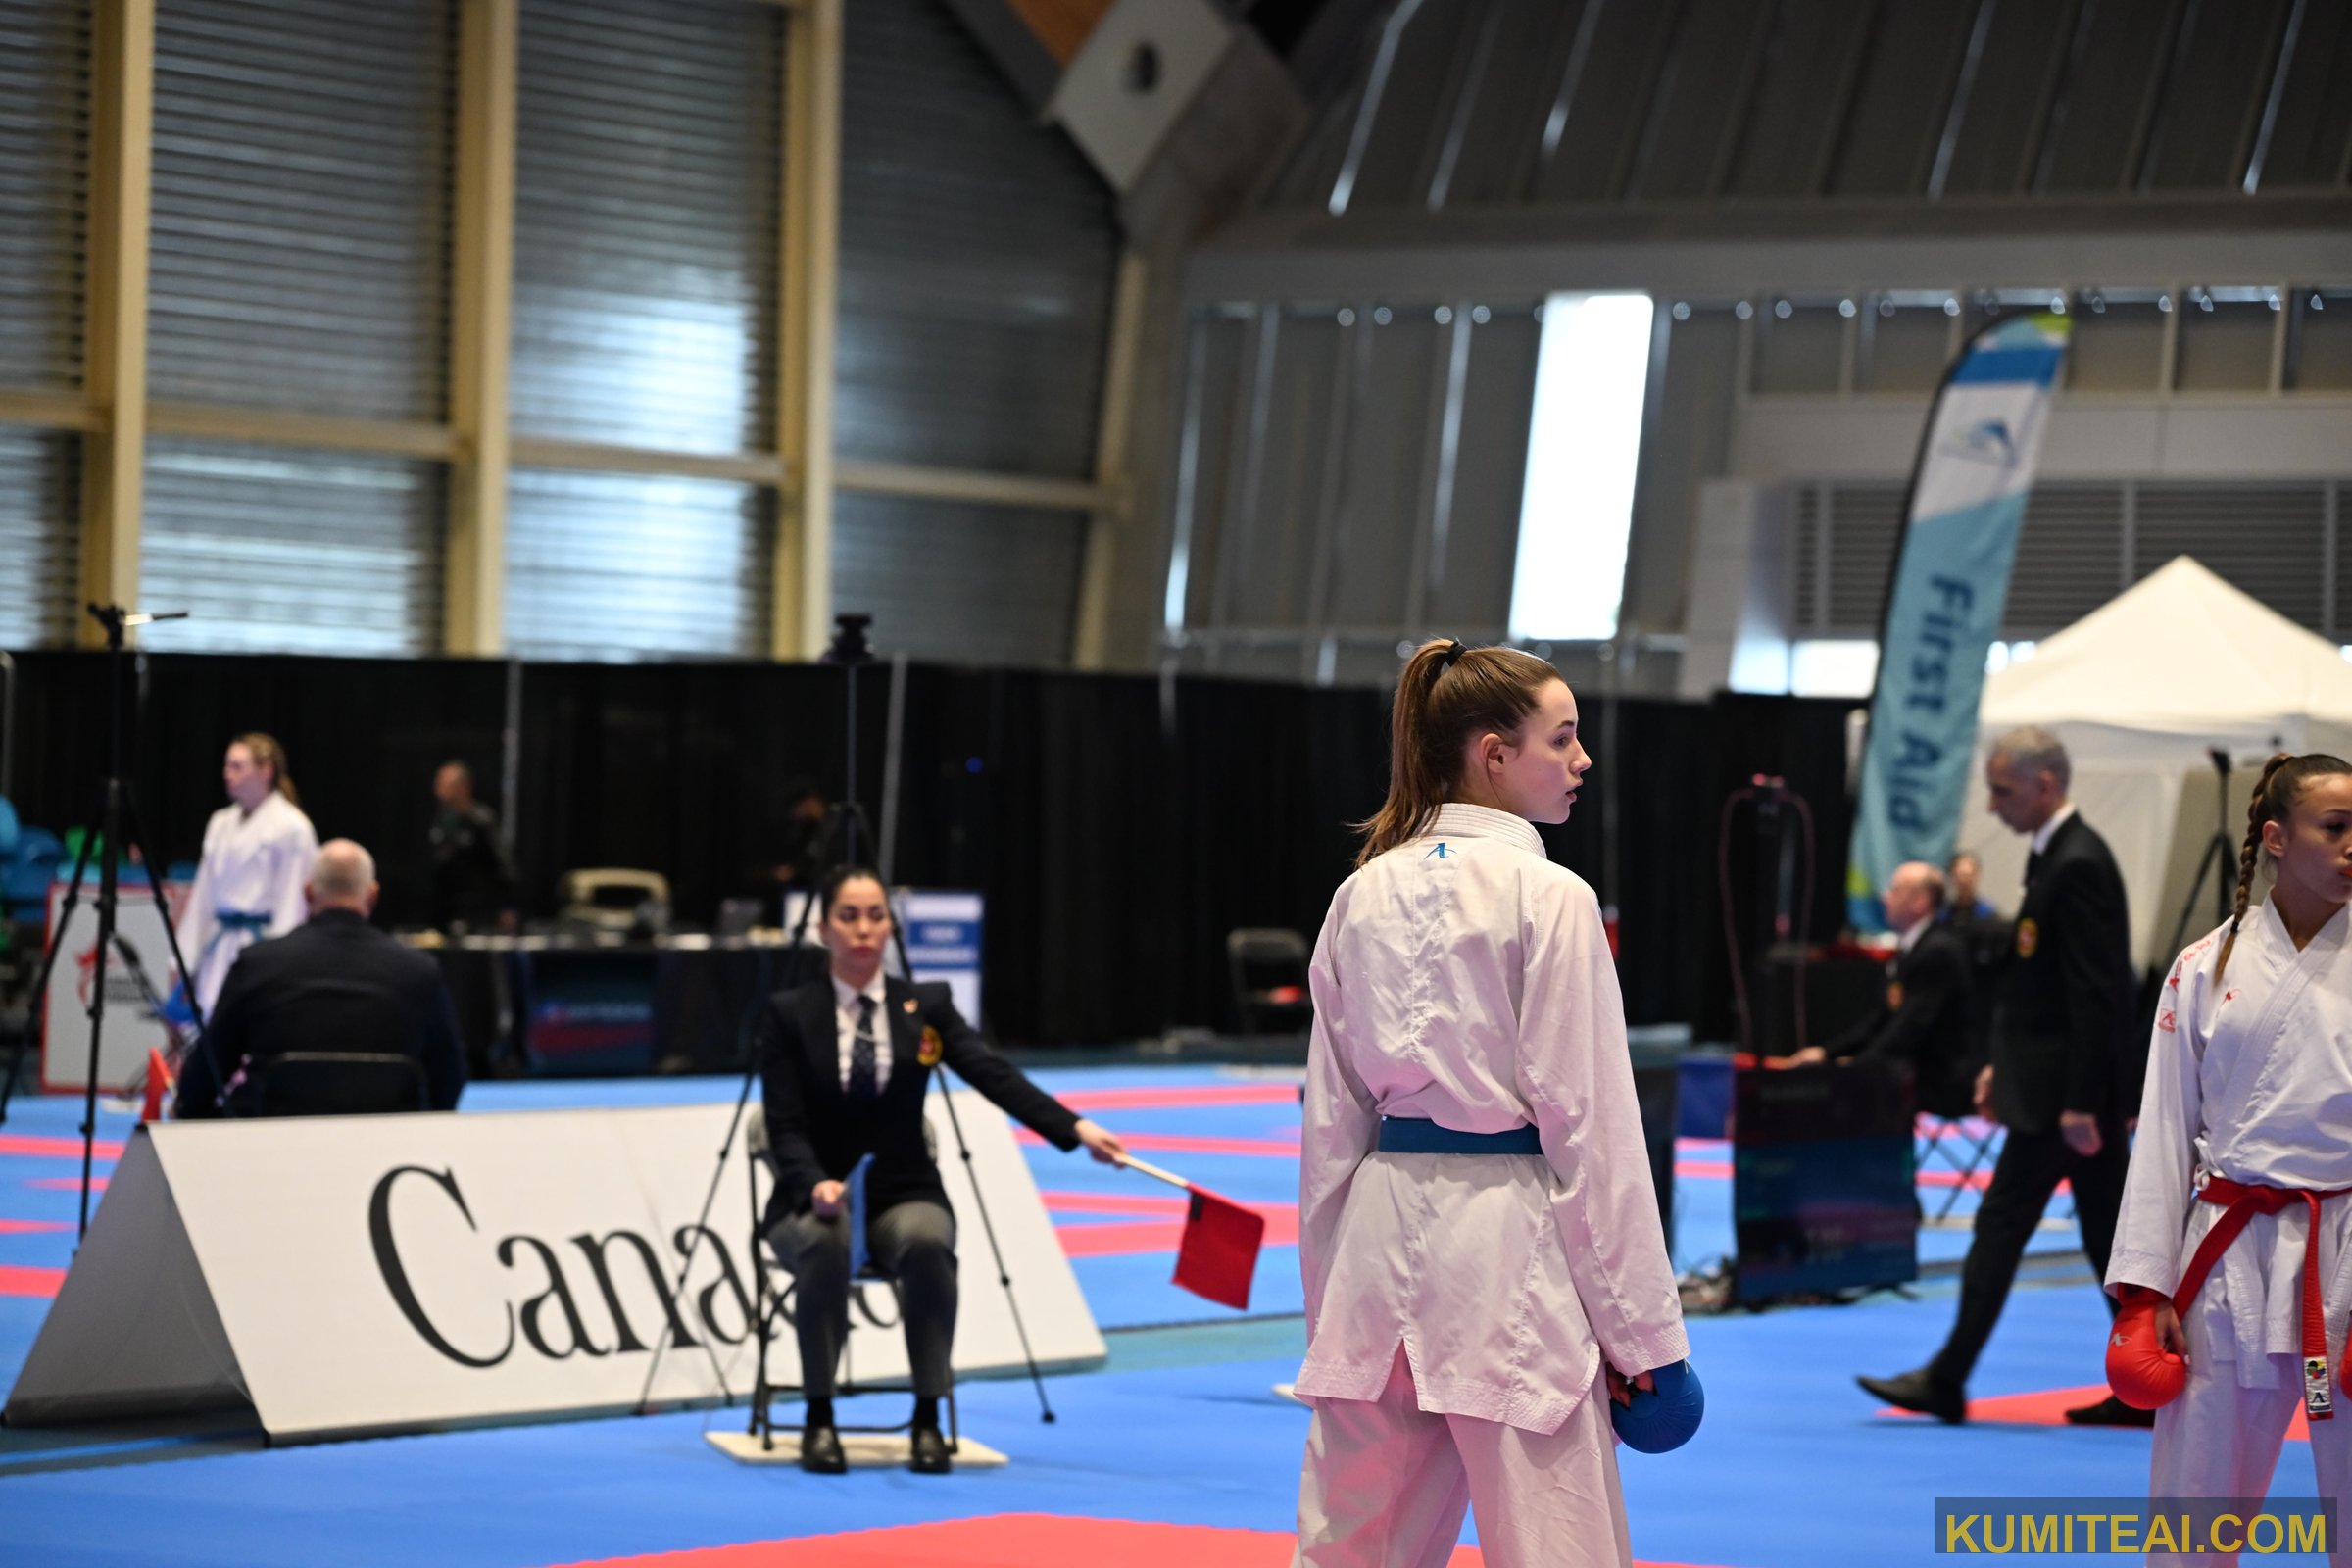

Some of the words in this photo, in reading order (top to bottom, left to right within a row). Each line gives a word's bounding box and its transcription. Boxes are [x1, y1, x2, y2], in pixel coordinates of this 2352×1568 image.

[1905, 572, 1975, 715] First
[1886, 729, 1944, 833] Aid
[368, 1165, 902, 1368] Cana
